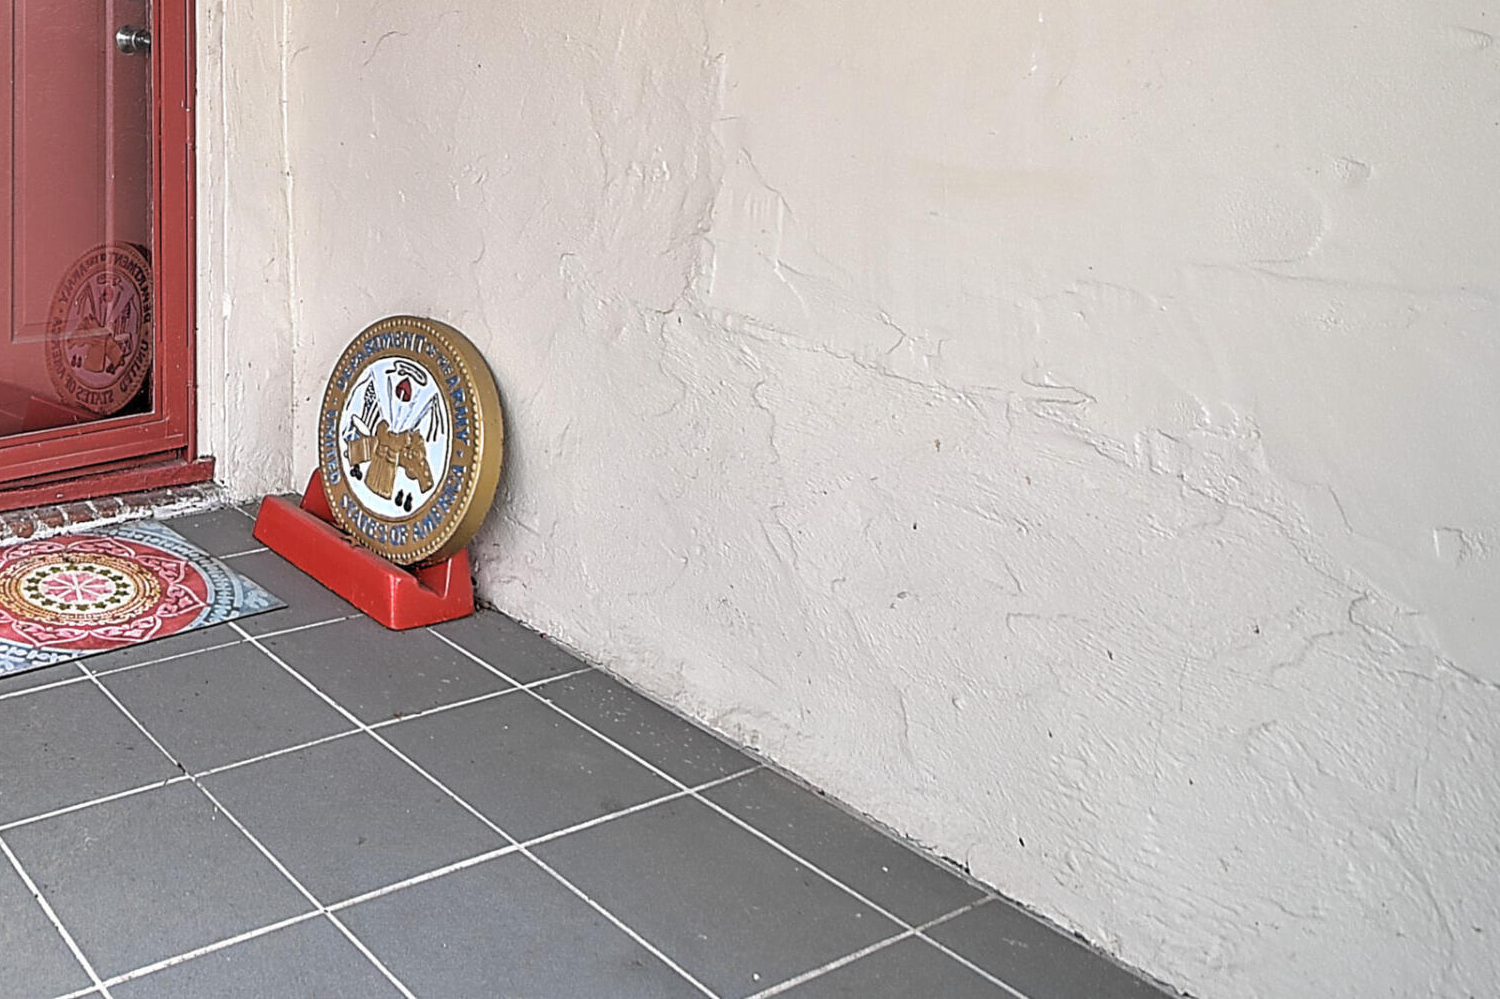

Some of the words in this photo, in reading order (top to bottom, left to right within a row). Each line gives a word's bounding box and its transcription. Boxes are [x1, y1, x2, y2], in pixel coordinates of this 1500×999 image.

[446, 375, 471, 447] ARMY
[324, 408, 341, 486] UNITED
[340, 493, 387, 544] STATES
[389, 524, 409, 546] OF
[412, 464, 467, 542] AMERICA
